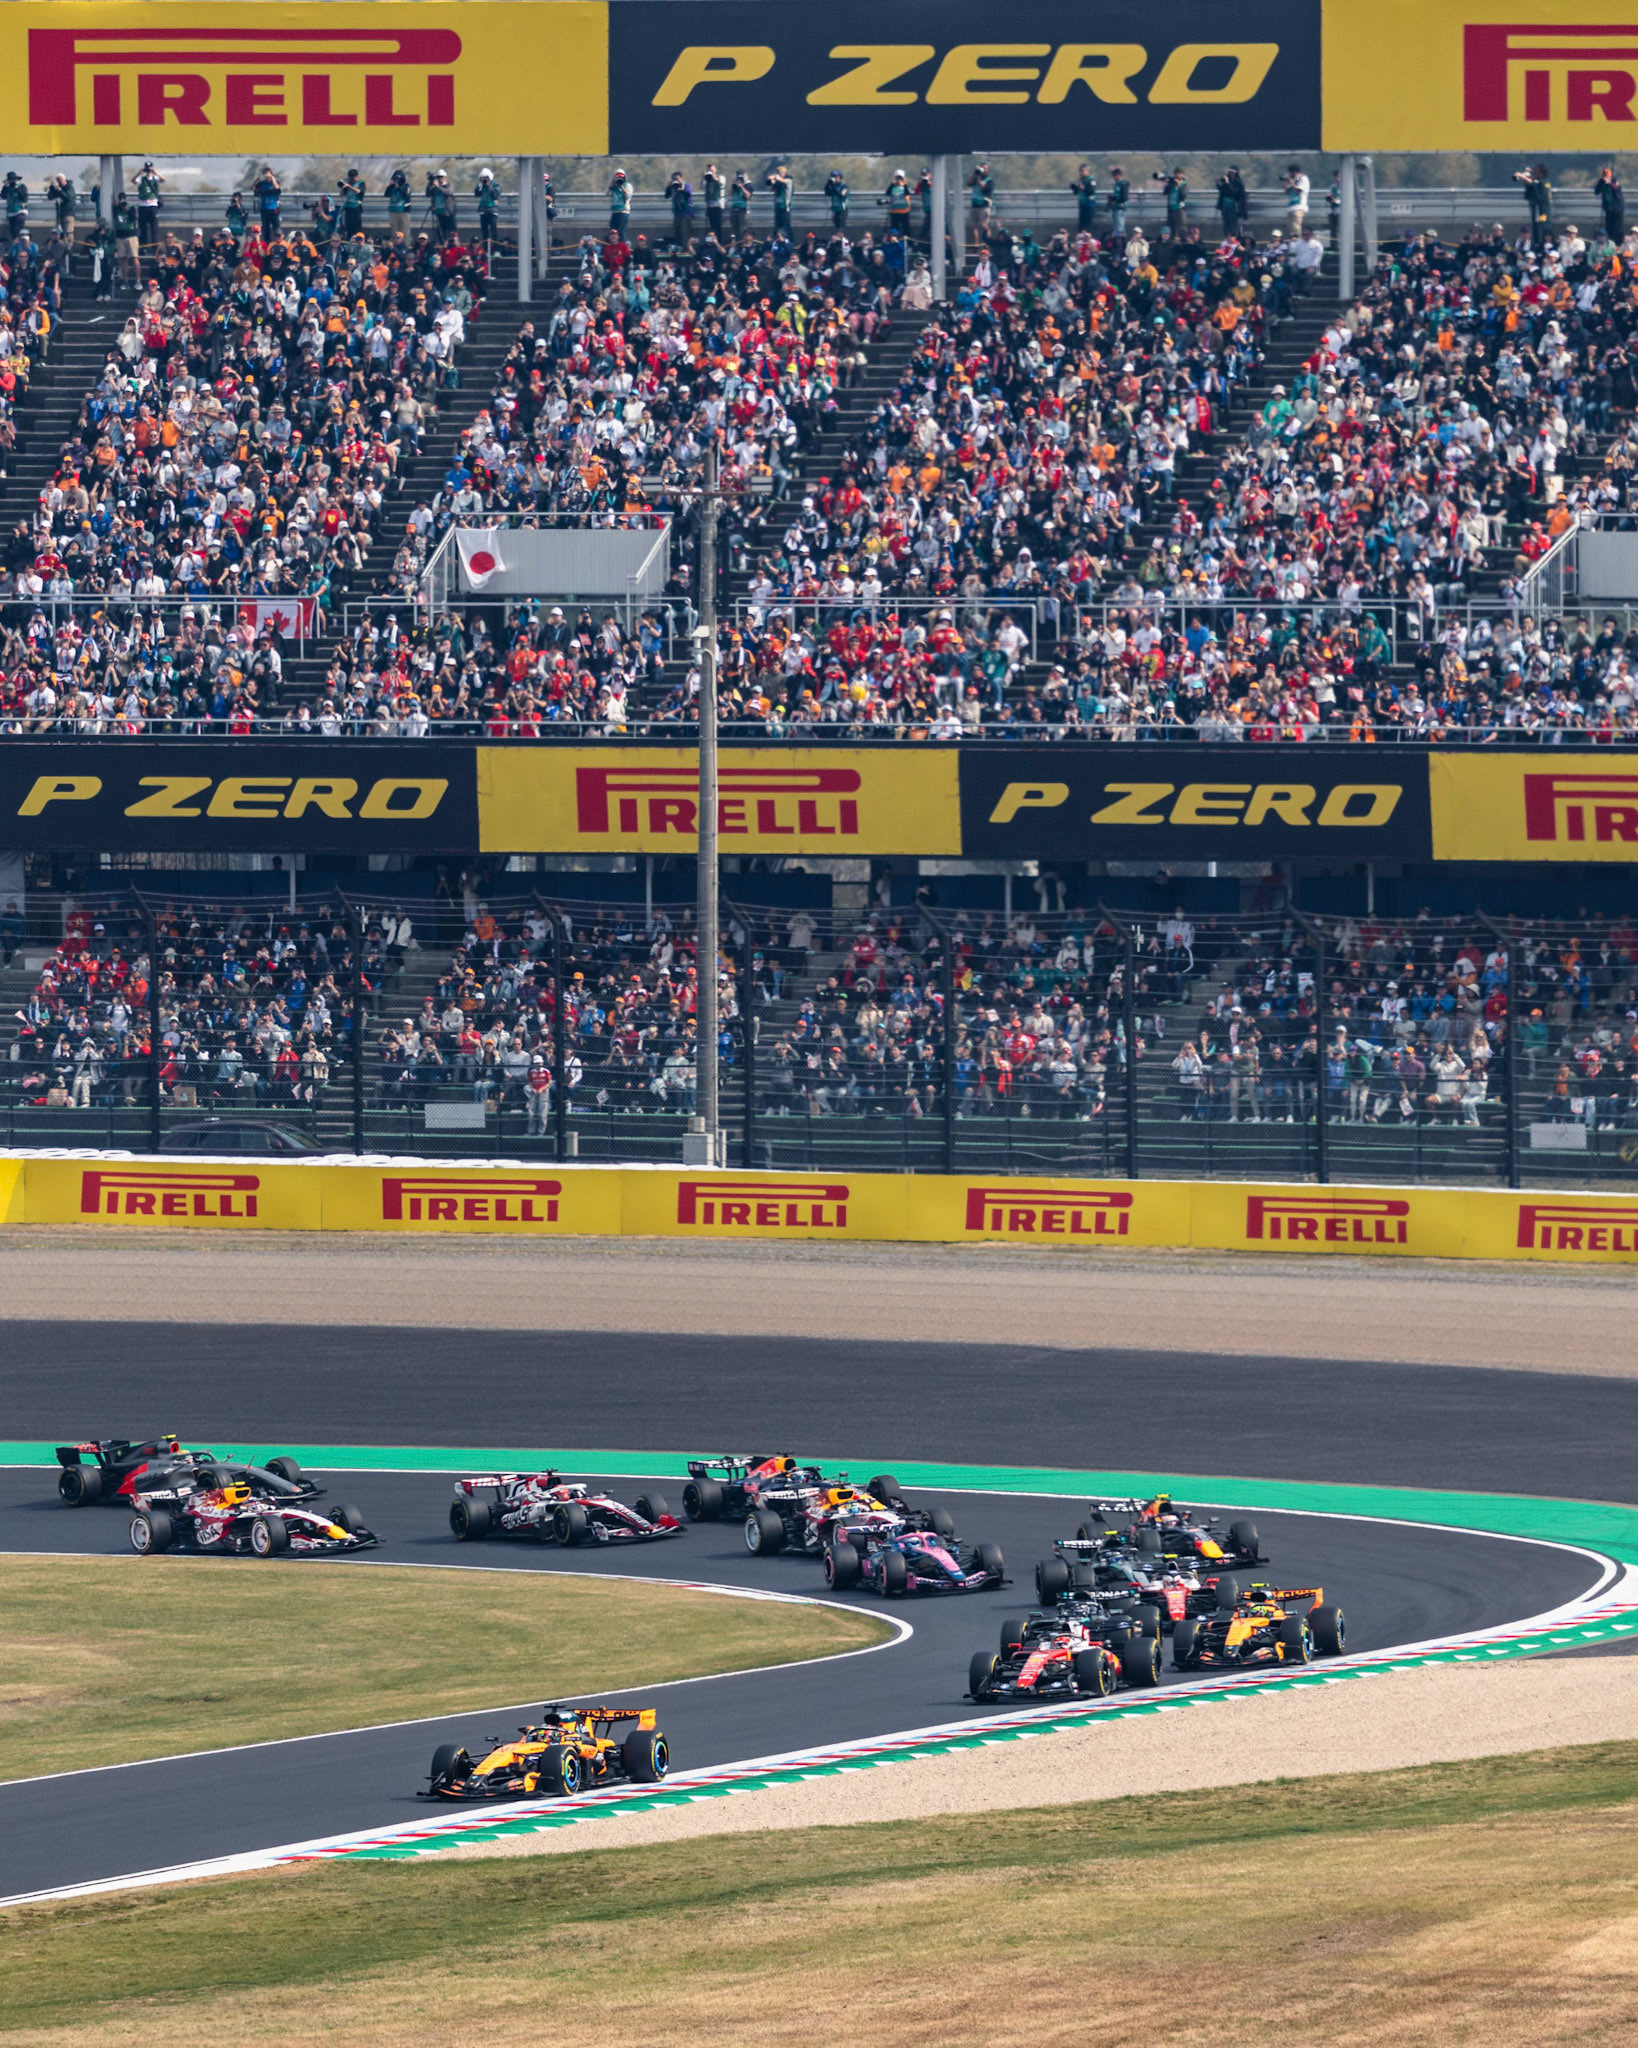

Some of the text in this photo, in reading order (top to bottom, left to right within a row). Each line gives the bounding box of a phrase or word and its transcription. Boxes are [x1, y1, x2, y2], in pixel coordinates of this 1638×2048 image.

[28, 28, 462, 126] PIRELLI
[652, 43, 1279, 106] P ZERO
[17, 775, 449, 819] P ZERO
[576, 767, 862, 834] PIRELLI
[989, 782, 1403, 826] P ZERO
[81, 1171, 260, 1217] PIRELLI
[382, 1178, 562, 1222] PIRELLI
[677, 1182, 849, 1227] PIRELLI
[966, 1188, 1133, 1236] PIRELLI
[1247, 1196, 1410, 1244] PIRELLI
[1517, 1205, 1638, 1252] PIREL
